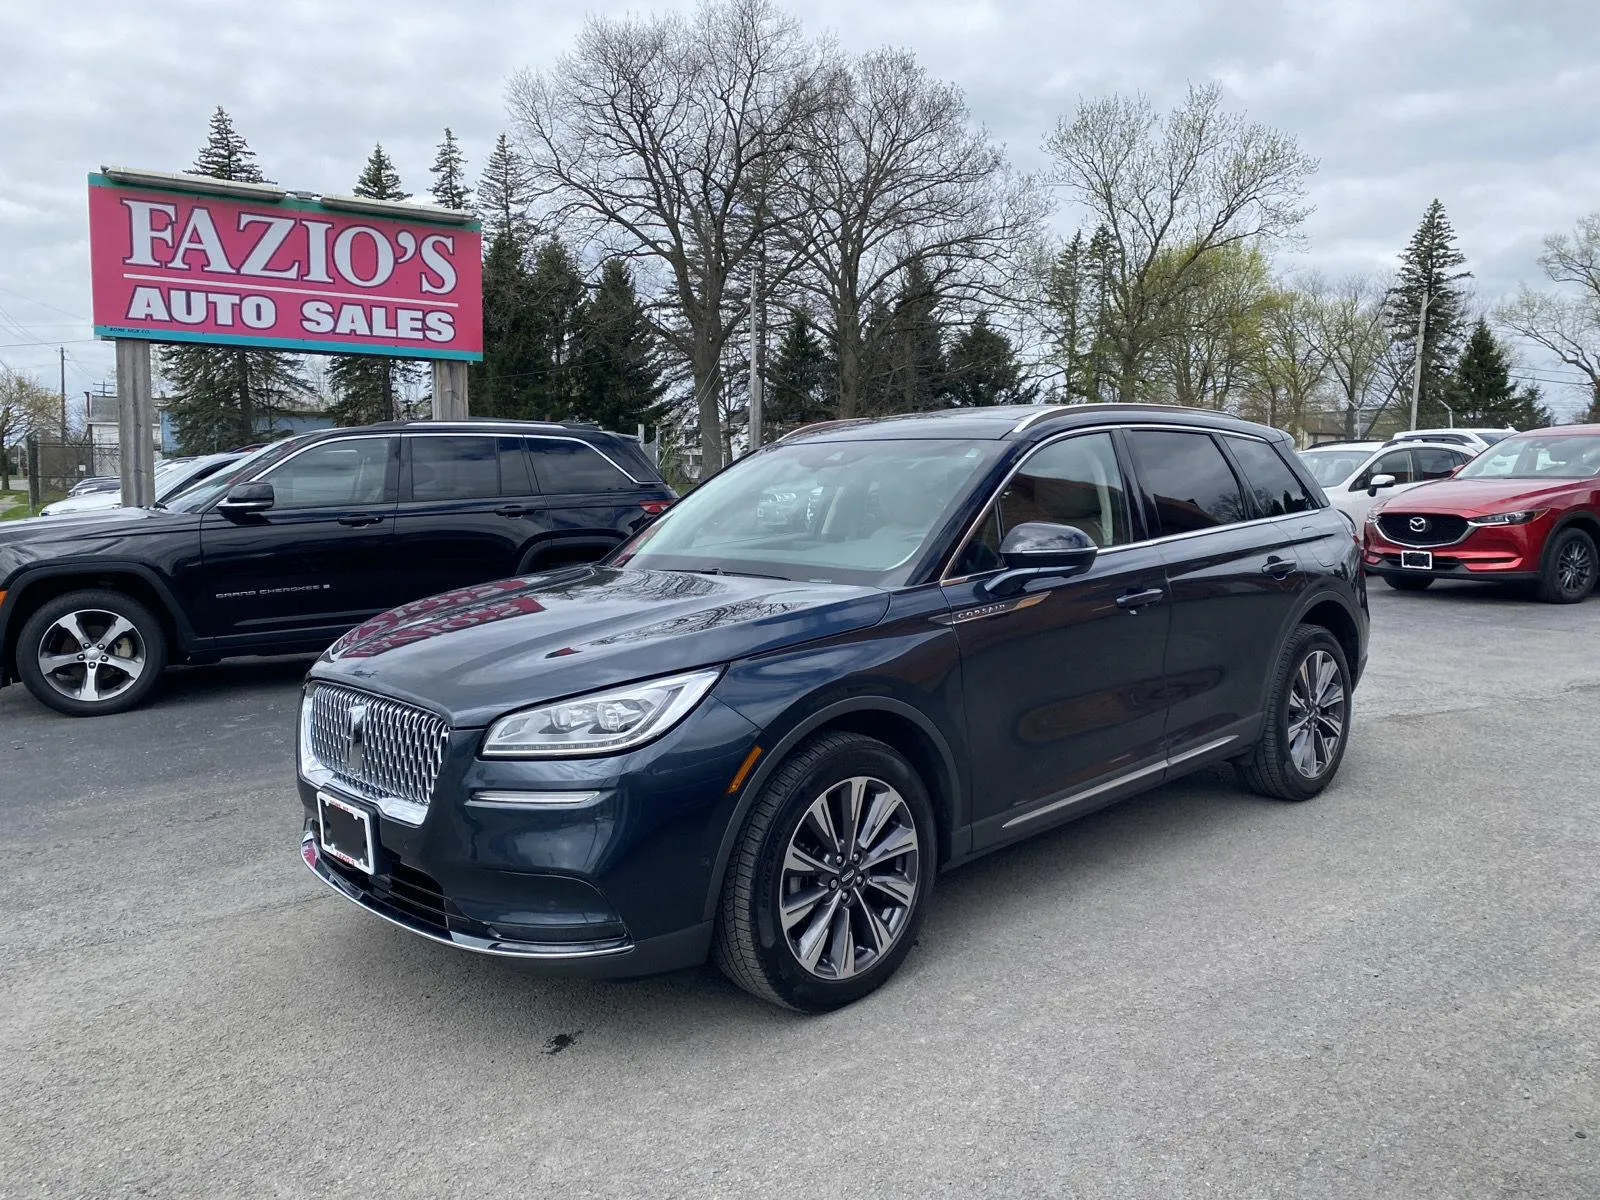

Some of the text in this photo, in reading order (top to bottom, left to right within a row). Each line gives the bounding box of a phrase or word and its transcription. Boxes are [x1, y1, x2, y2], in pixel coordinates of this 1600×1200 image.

[121, 198, 459, 295] FAZIO'S
[126, 286, 456, 343] AUTO SALES
[215, 584, 320, 599] GRAND CHEROKEE
